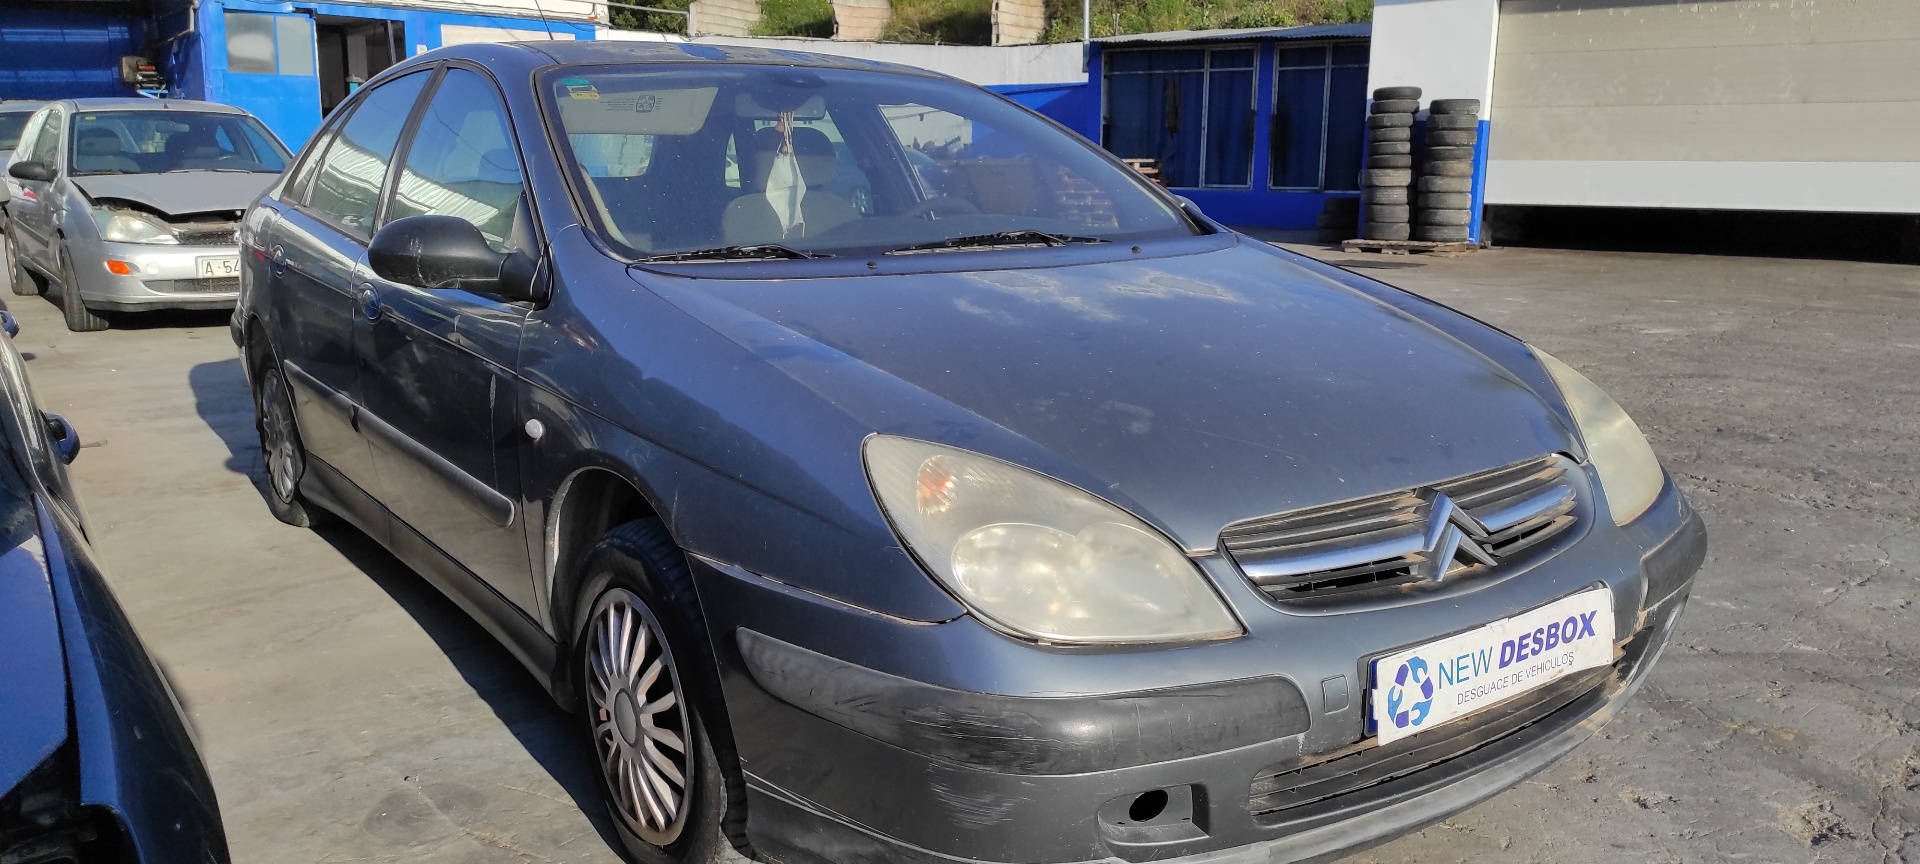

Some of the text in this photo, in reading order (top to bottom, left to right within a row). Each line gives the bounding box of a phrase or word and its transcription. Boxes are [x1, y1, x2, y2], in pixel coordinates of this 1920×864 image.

[1438, 610, 1597, 689] NEW DESBOX
[1457, 651, 1574, 704] DESGUACE DE VEHICULOS
